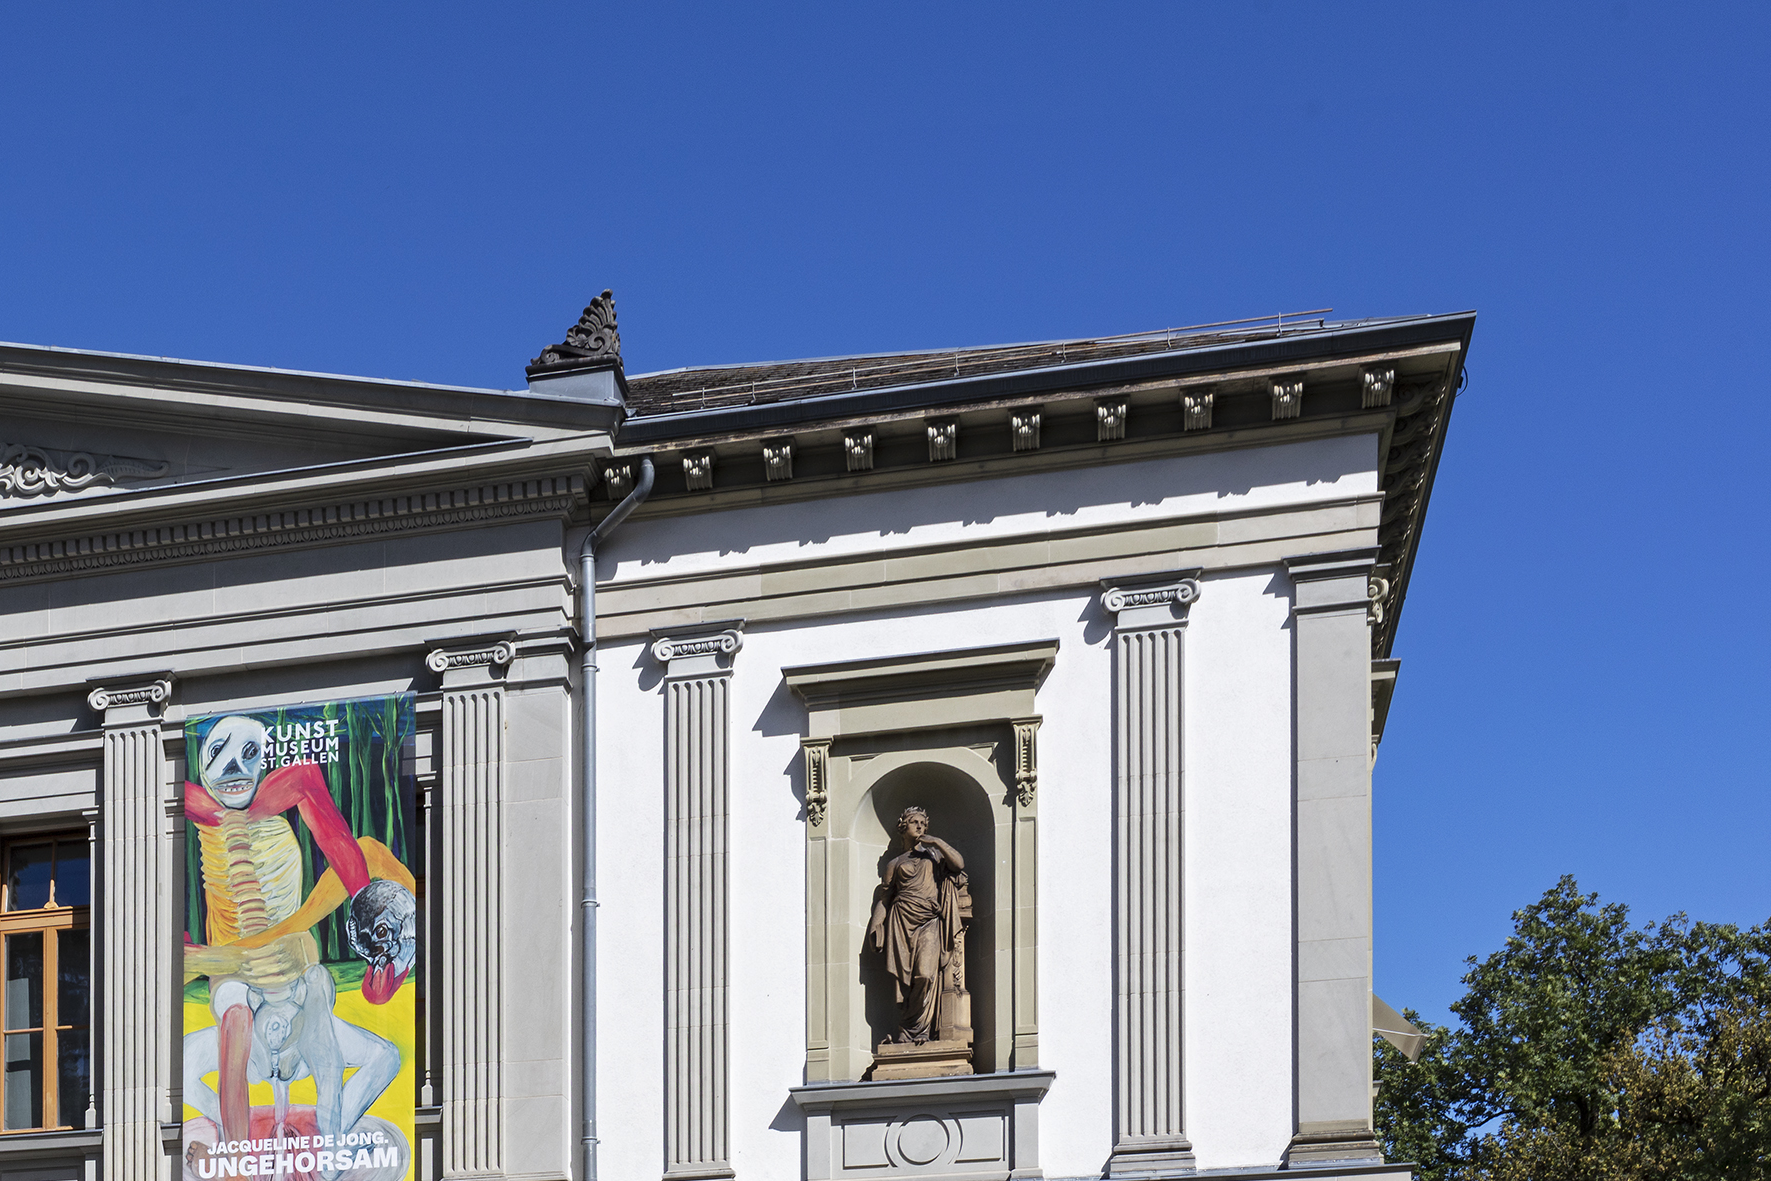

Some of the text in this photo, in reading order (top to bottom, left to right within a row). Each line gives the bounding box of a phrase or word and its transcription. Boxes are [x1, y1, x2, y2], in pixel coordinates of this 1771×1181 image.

[260, 719, 339, 743] KUNST
[260, 737, 339, 758] MUSEUM
[207, 1131, 389, 1155] JACQUELINE DE JONG.
[198, 1147, 398, 1179] UNGEHORSAM
